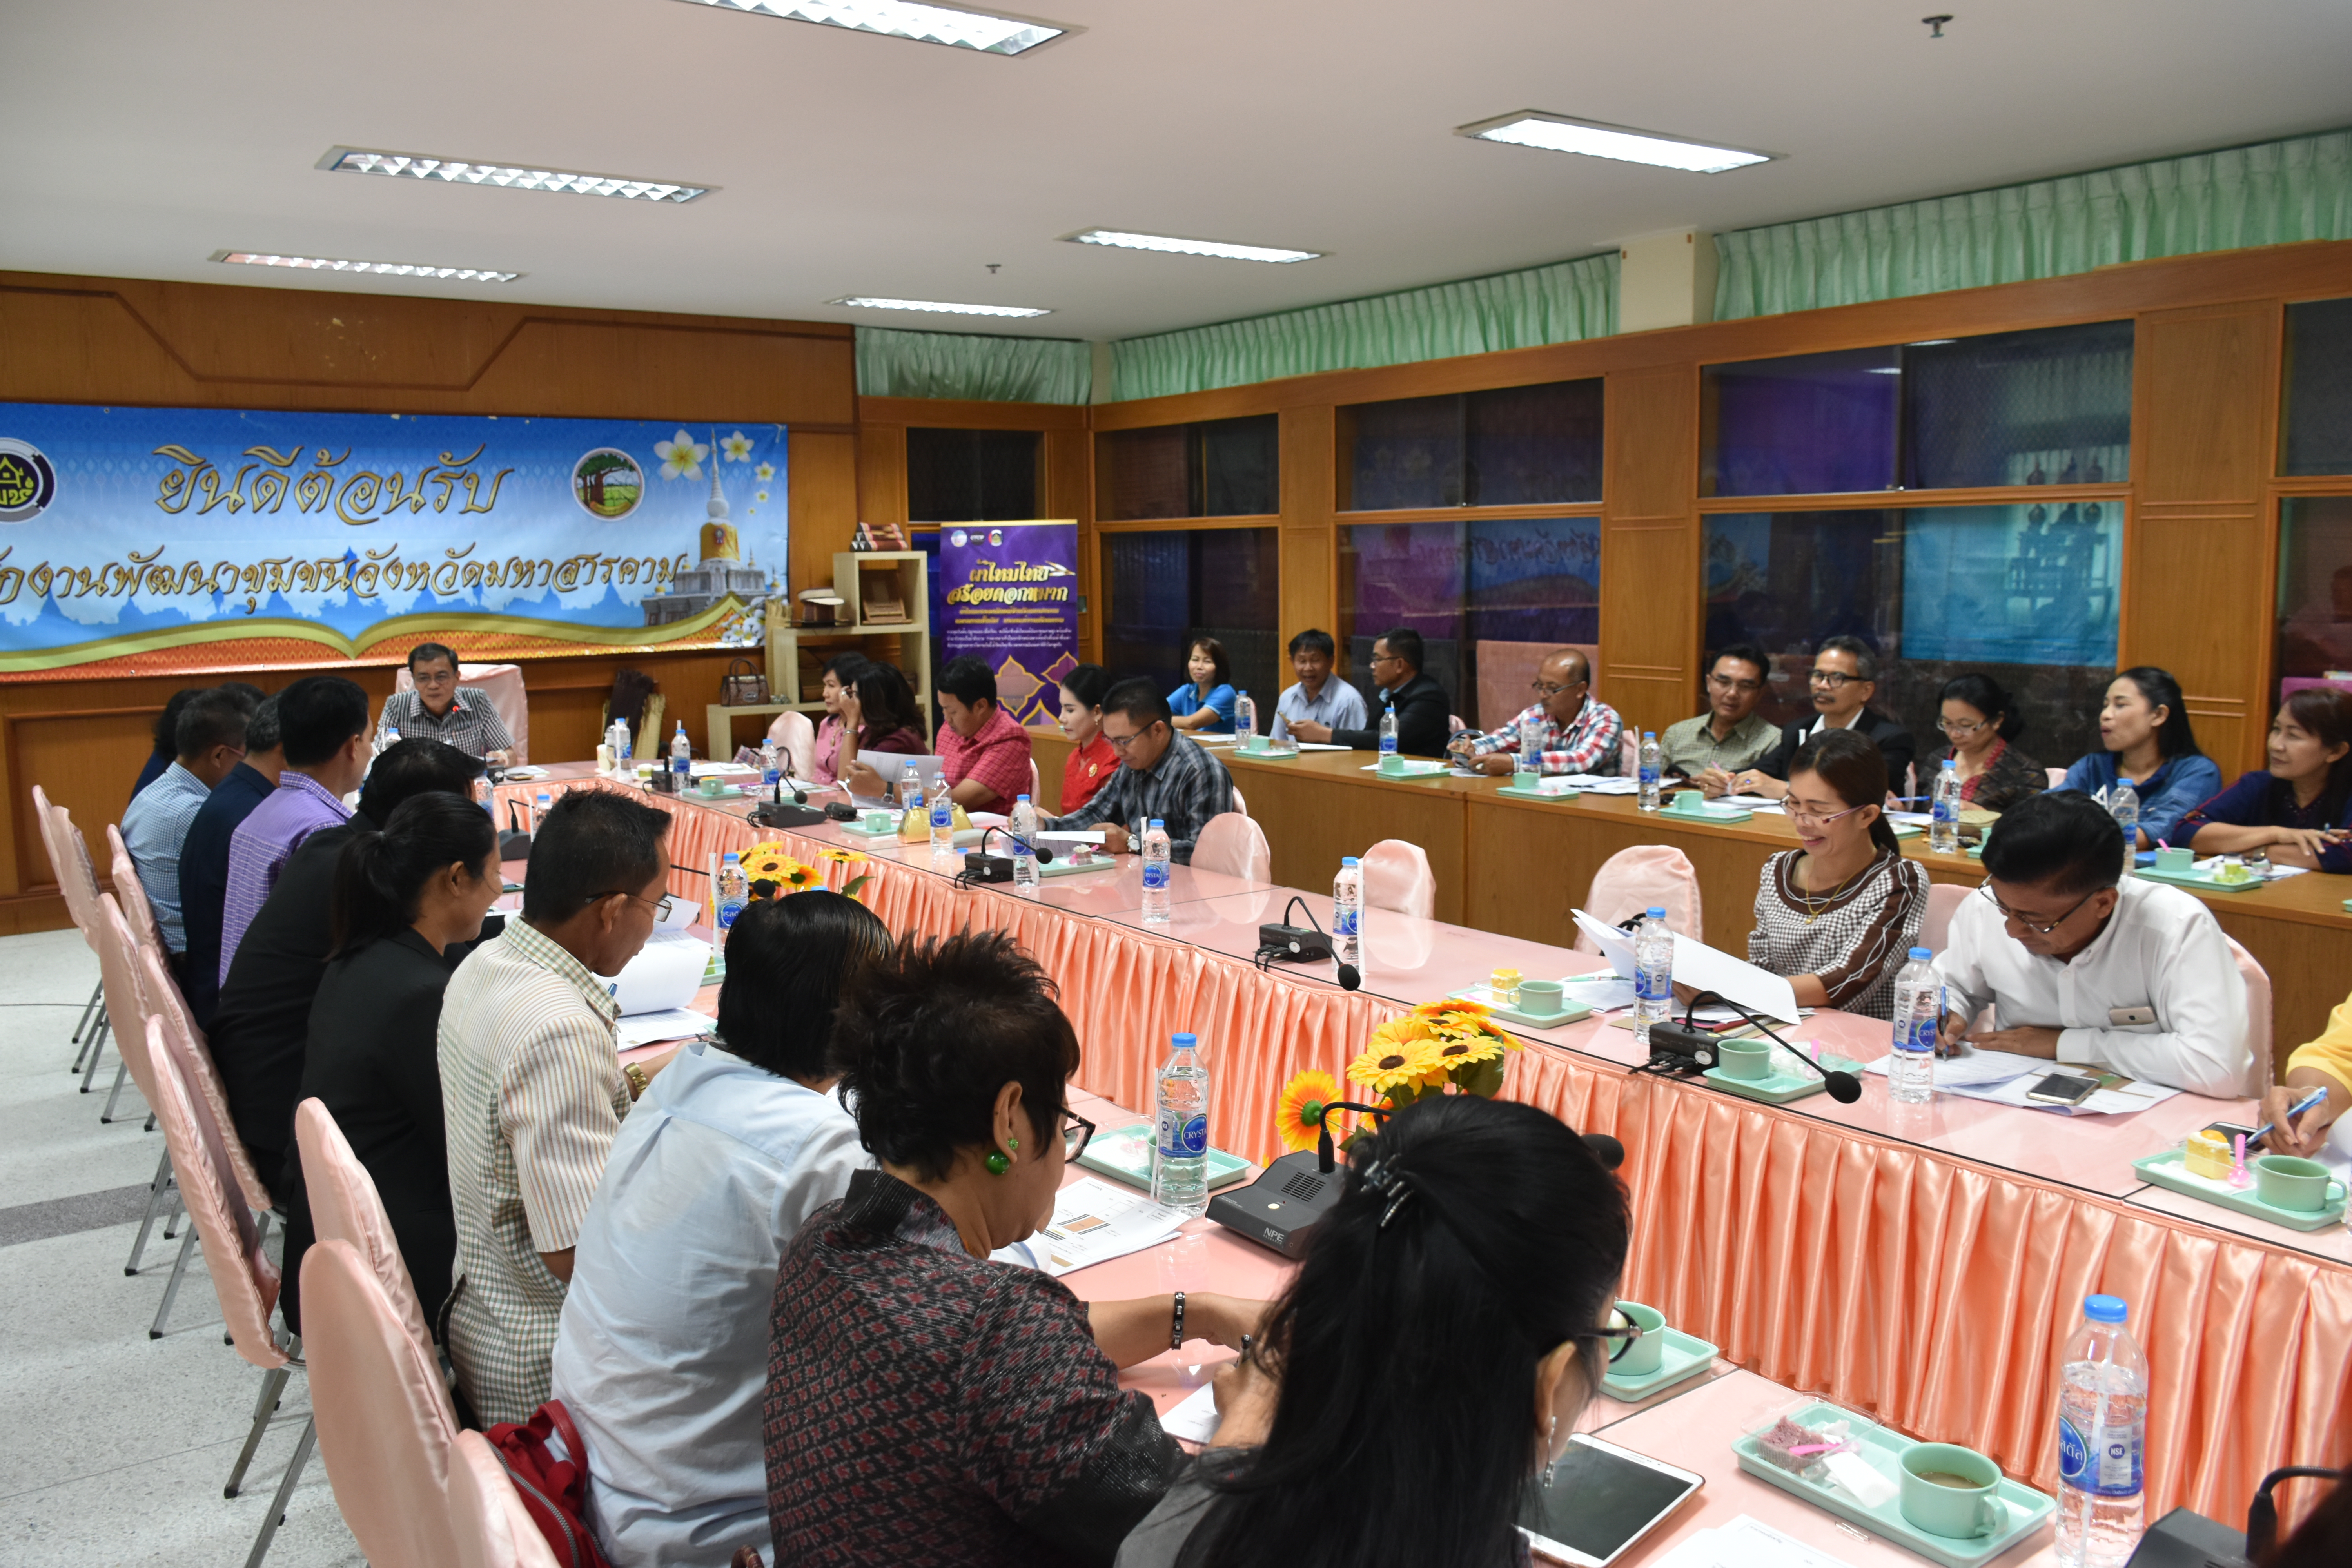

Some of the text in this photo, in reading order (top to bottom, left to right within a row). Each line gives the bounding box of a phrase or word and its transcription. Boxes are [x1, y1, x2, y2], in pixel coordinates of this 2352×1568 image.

[152, 443, 514, 525] ยินดีต้อนรับ
[1183, 1128, 1207, 1139] CRYSTA
[1264, 1227, 1285, 1242] NPE
